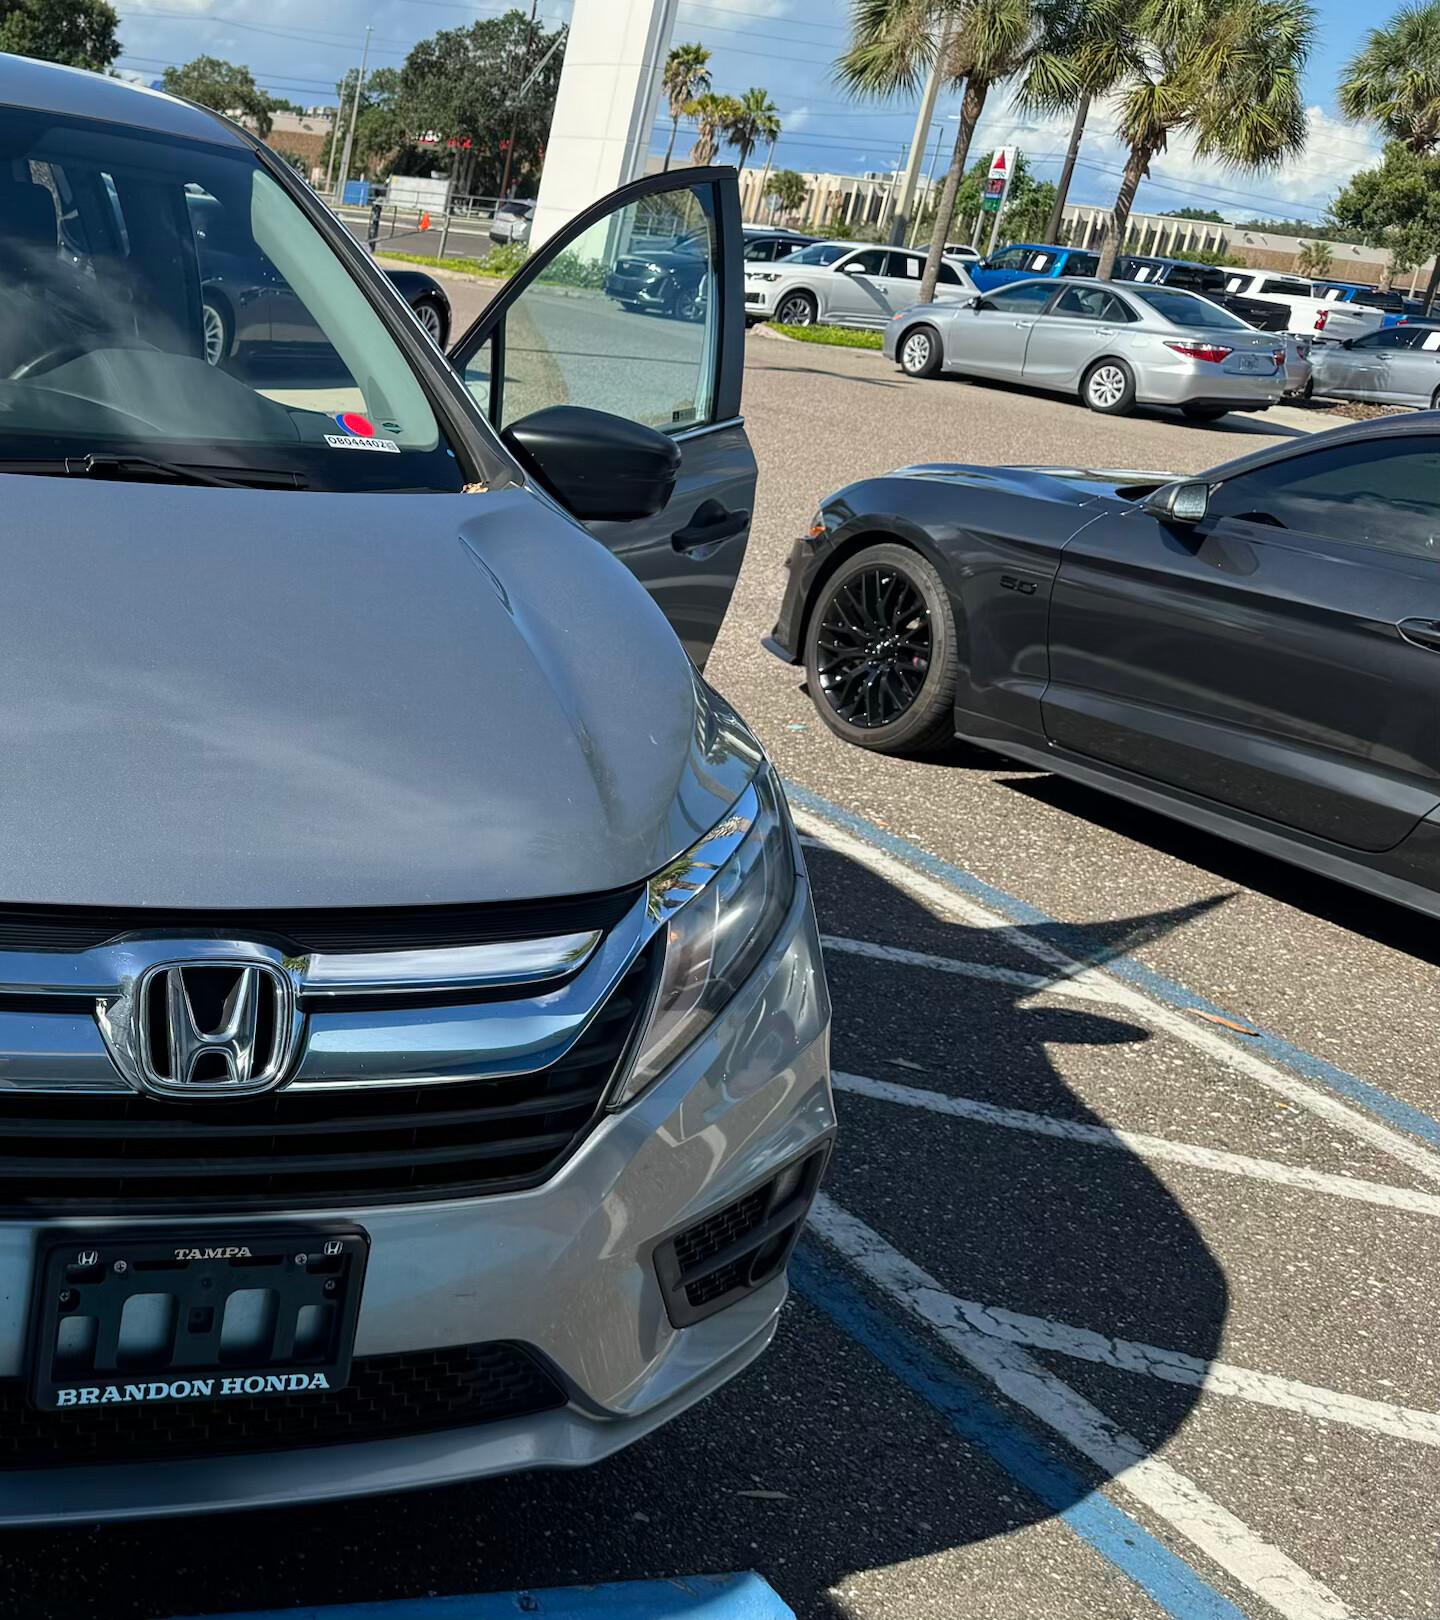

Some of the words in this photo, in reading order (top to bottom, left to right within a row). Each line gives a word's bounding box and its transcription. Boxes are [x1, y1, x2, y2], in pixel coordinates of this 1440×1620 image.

[174, 1246, 253, 1260] TAMPA
[56, 1379, 216, 1407] BRANDON
[219, 1372, 330, 1396] HONDA
